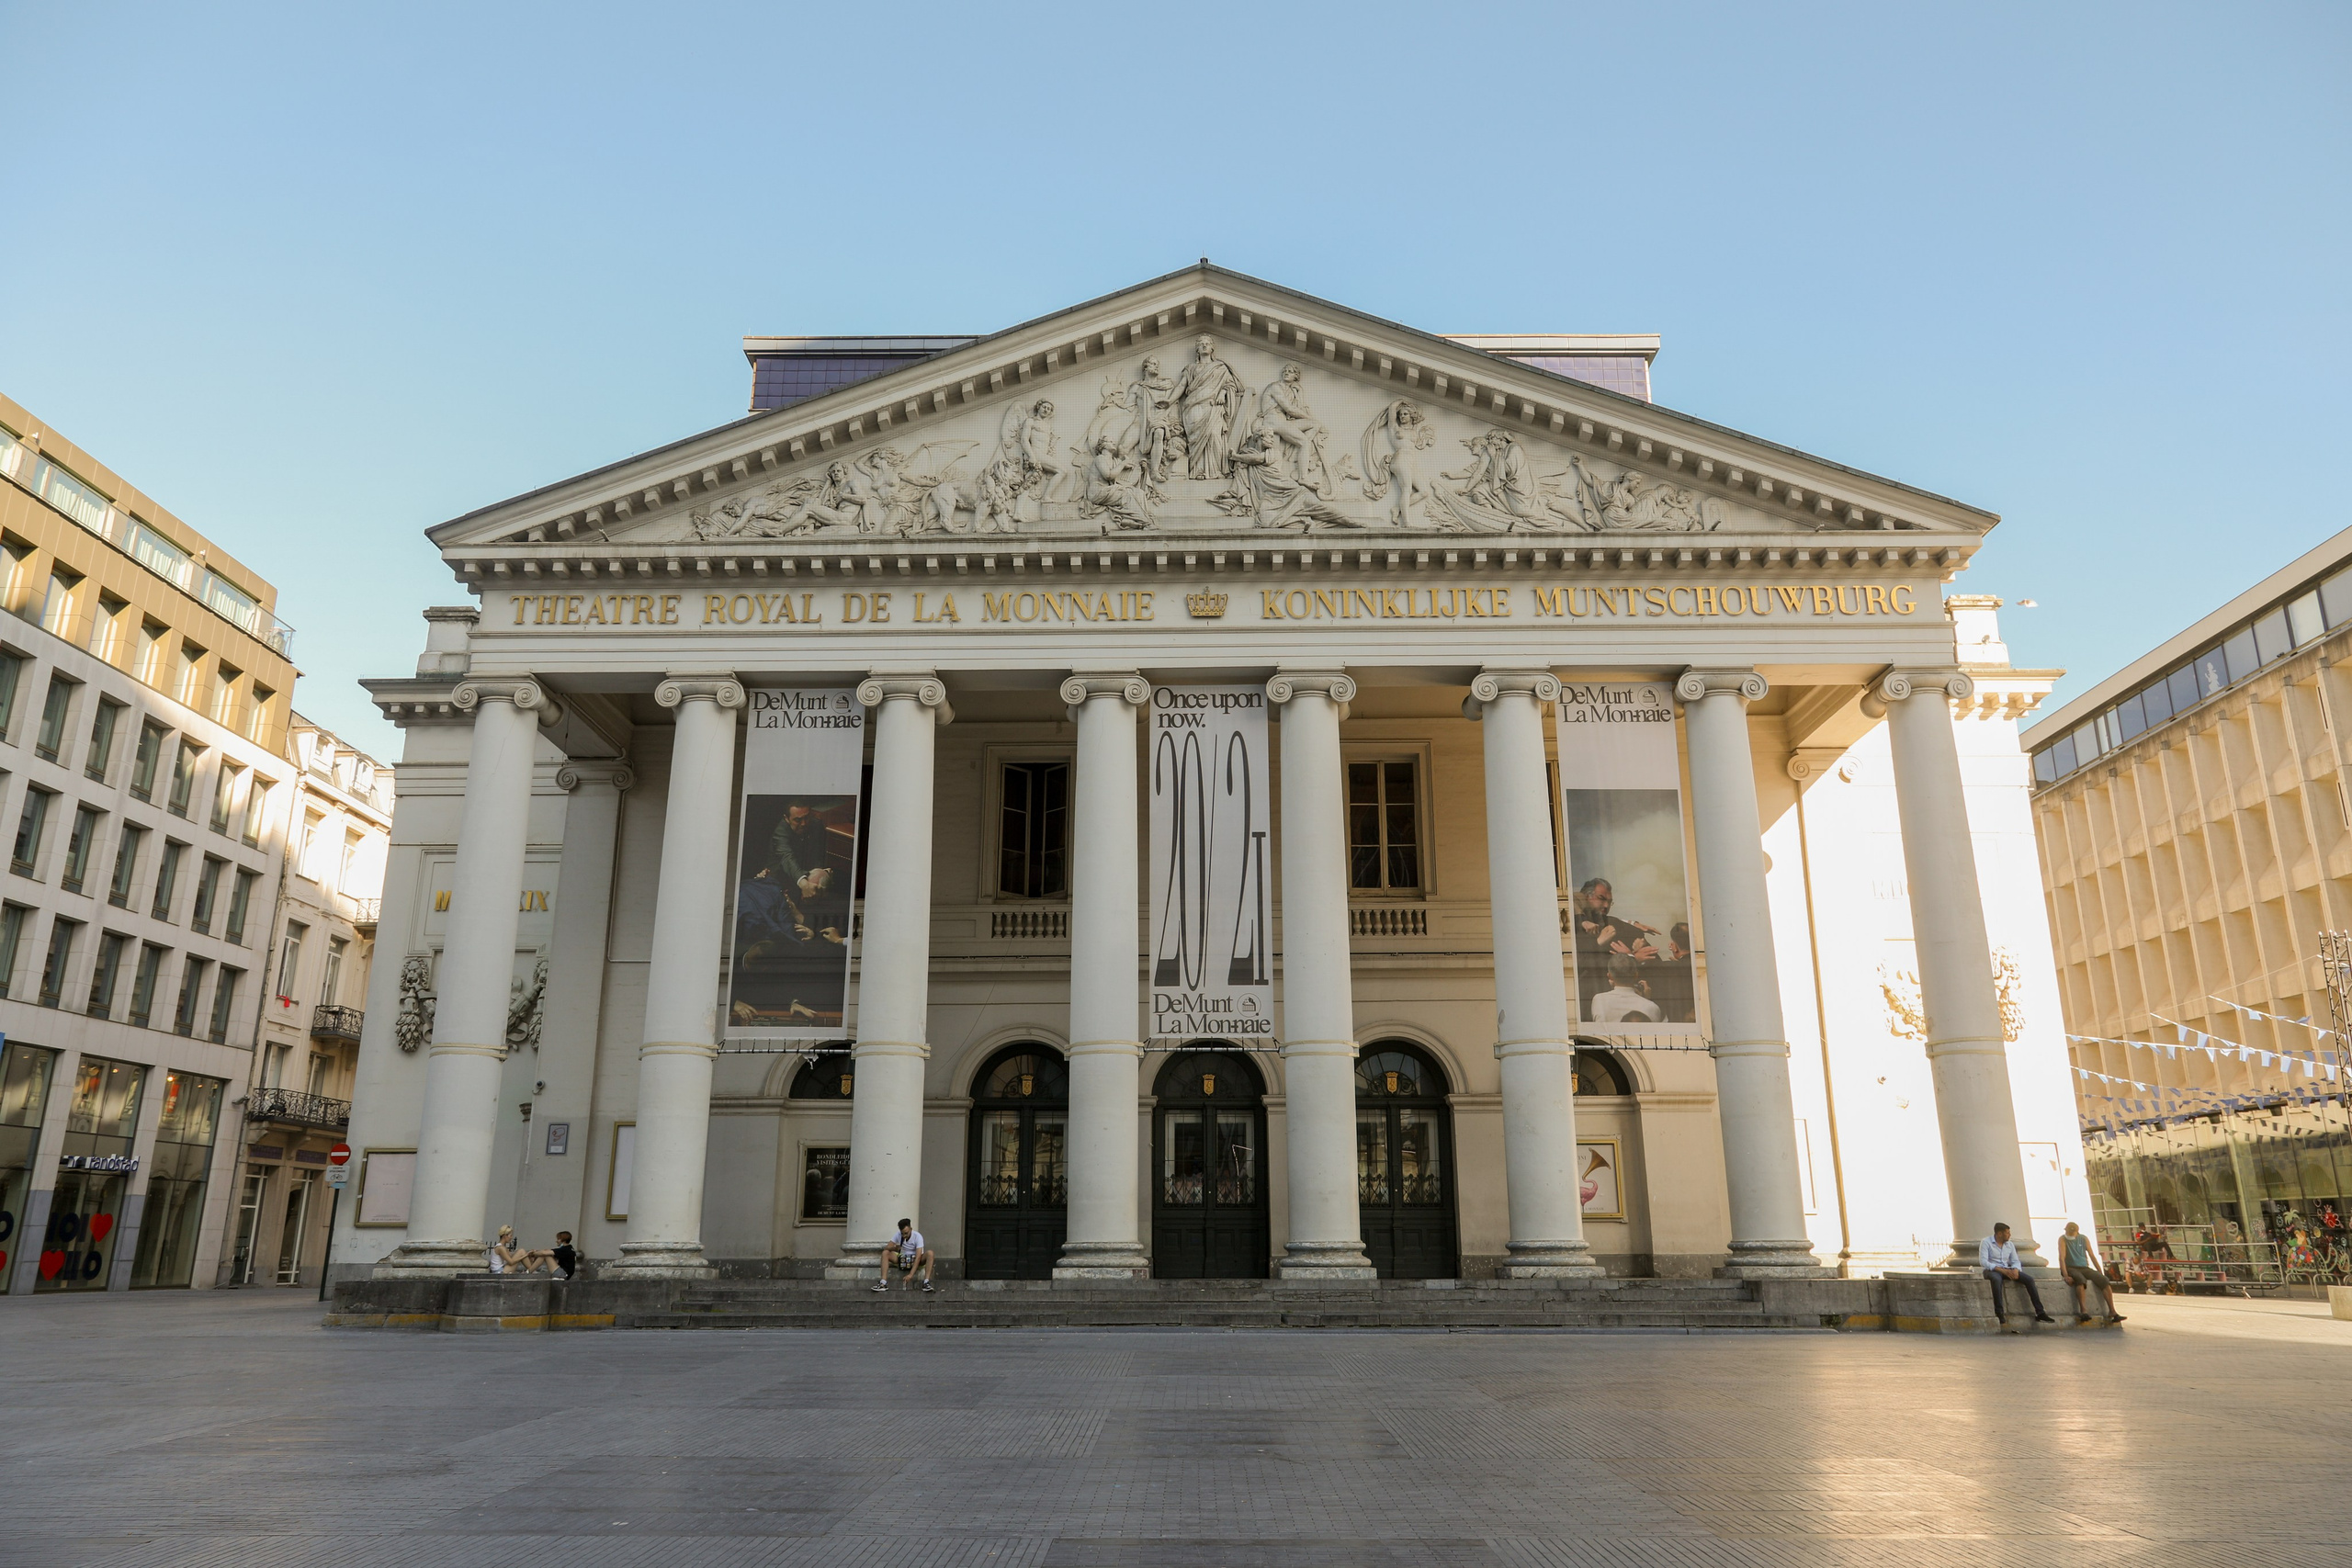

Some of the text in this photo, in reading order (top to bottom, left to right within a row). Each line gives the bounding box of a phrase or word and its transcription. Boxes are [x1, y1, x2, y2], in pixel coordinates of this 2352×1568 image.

[510, 584, 1917, 626] THEATRE ROYAL DE LA MONNAIE KONINKLIJKE MUNTSCHOUWBURG
[1153, 687, 1263, 715] Once upon
[754, 710, 779, 728] La
[1158, 713, 1206, 728] now.
[1563, 705, 1588, 723] La
[1157, 1014, 1182, 1033] La
[85, 1154, 140, 1172] randstad
